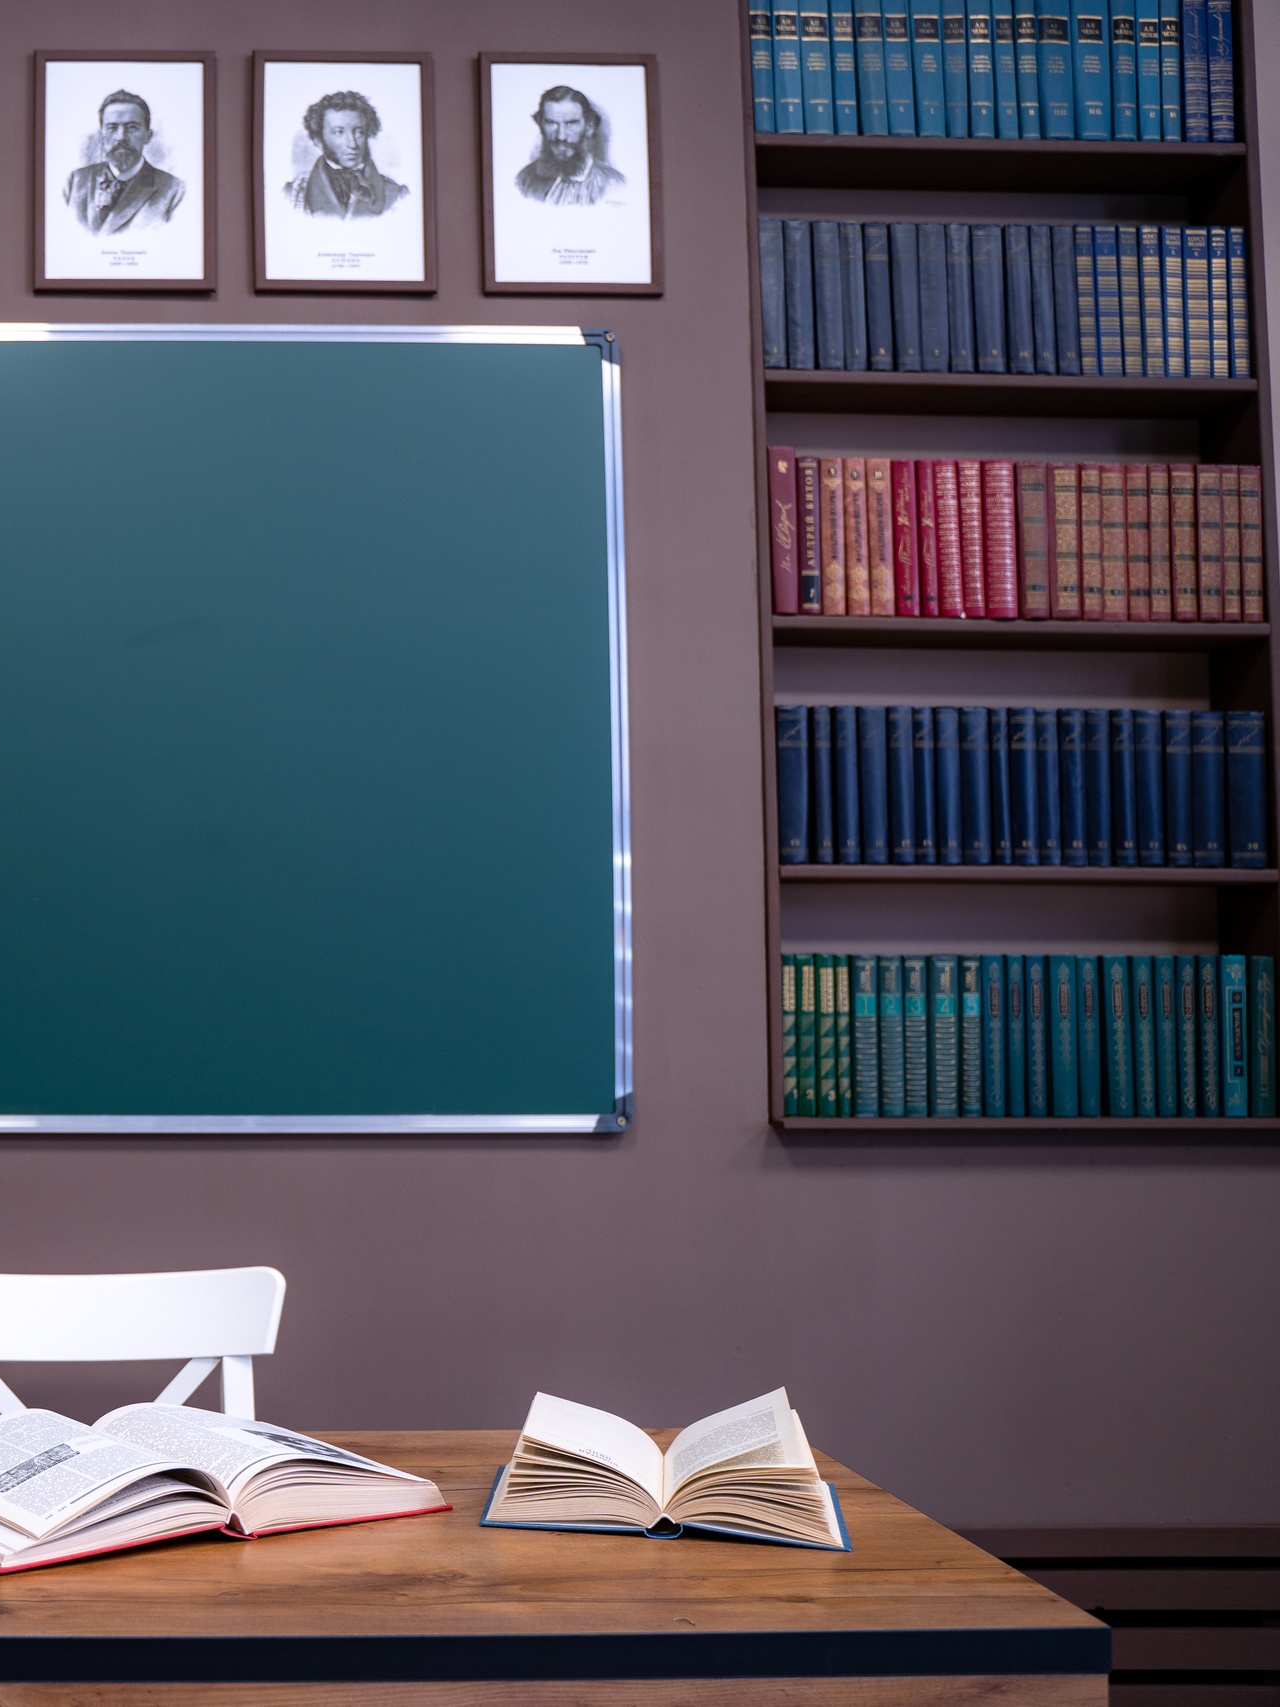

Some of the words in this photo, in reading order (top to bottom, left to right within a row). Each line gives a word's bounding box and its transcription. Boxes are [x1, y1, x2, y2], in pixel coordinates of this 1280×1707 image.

[804, 468, 814, 510] БИТОВ
[885, 996, 896, 1014] 2
[910, 996, 922, 1014] 3
[940, 996, 950, 1013] 4
[966, 996, 977, 1013] 5
